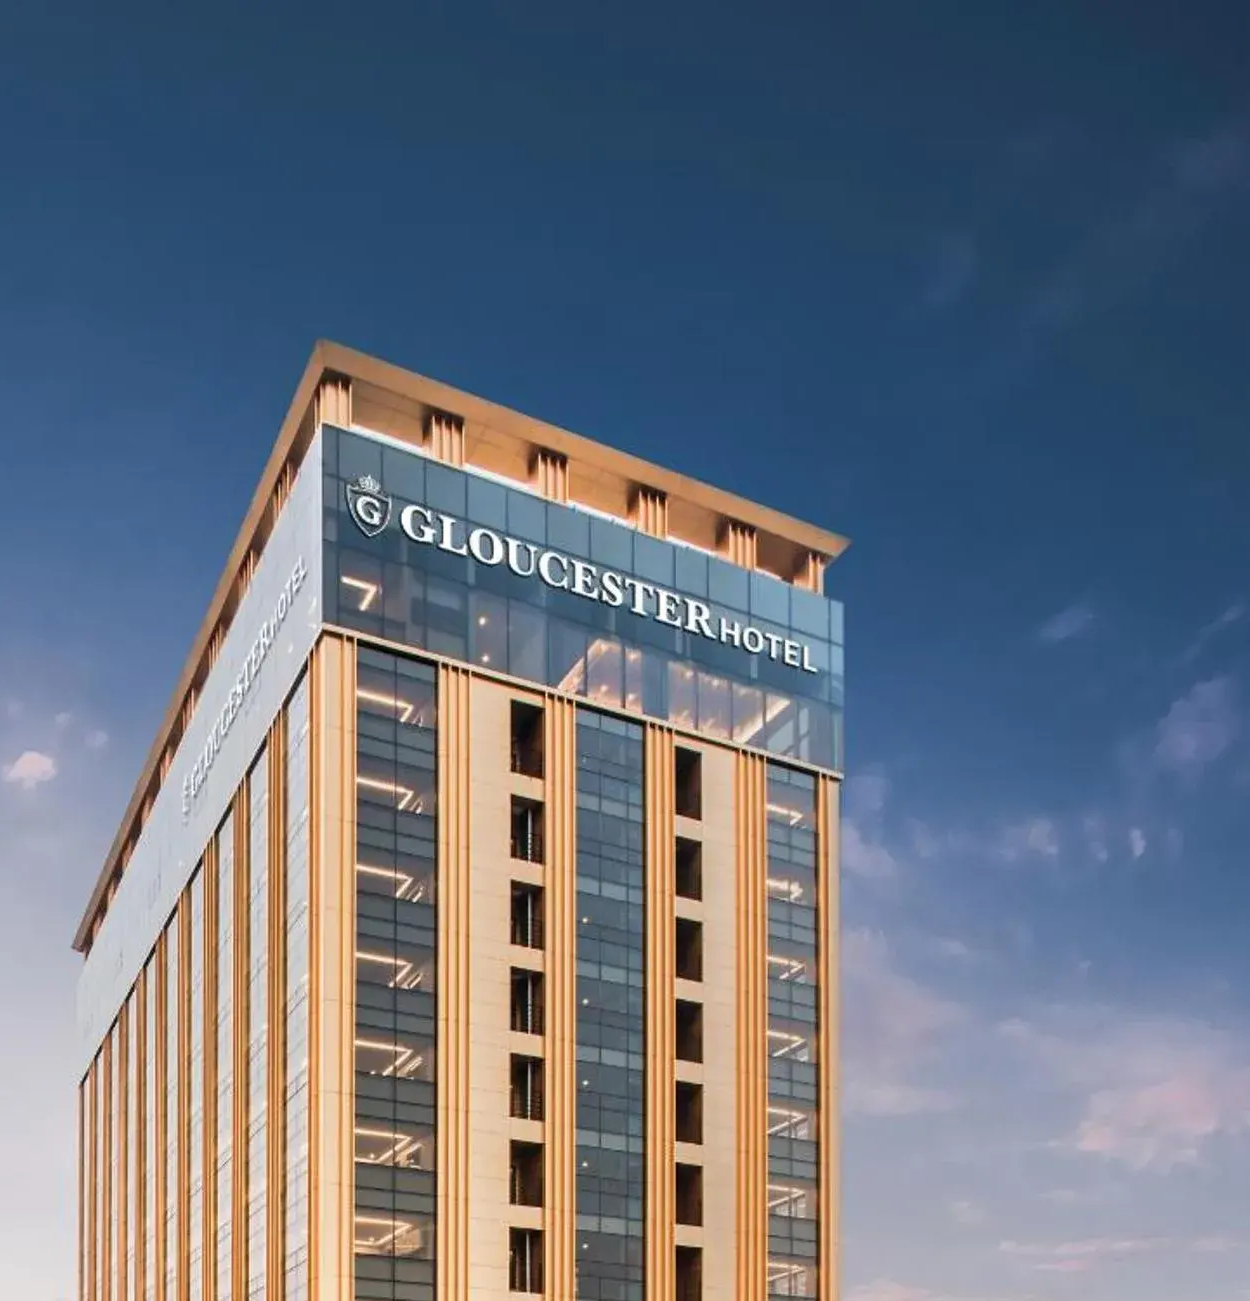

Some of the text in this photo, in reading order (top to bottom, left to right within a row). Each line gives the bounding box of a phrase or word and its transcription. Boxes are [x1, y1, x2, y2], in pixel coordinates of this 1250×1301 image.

[356, 496, 382, 526] G
[401, 504, 818, 674] GLOUCESTER HOTEL
